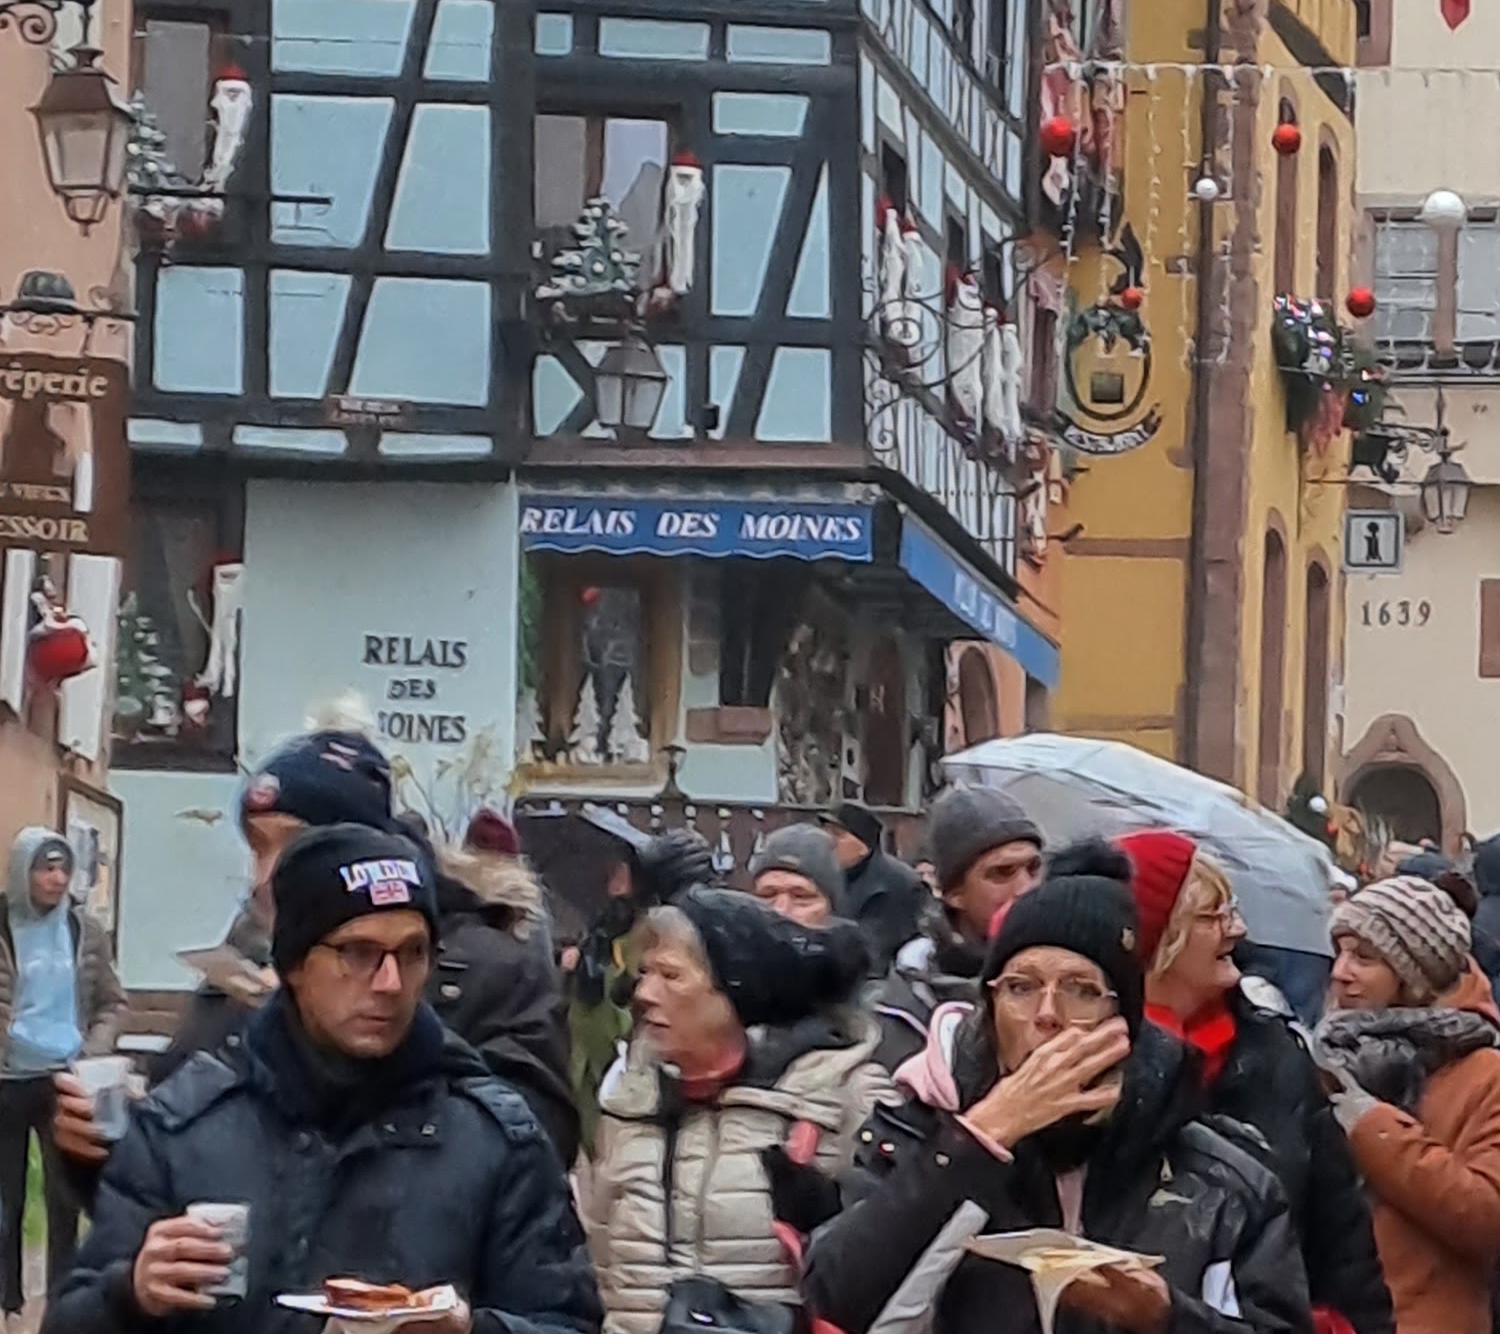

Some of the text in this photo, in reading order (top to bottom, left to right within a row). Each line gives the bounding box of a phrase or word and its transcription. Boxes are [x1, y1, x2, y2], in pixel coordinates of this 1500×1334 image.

[518, 507, 863, 542] RELAIS DES MOINES
[1361, 599, 1431, 626] 1639
[363, 634, 468, 668] RELAIS
[387, 677, 437, 700] DES
